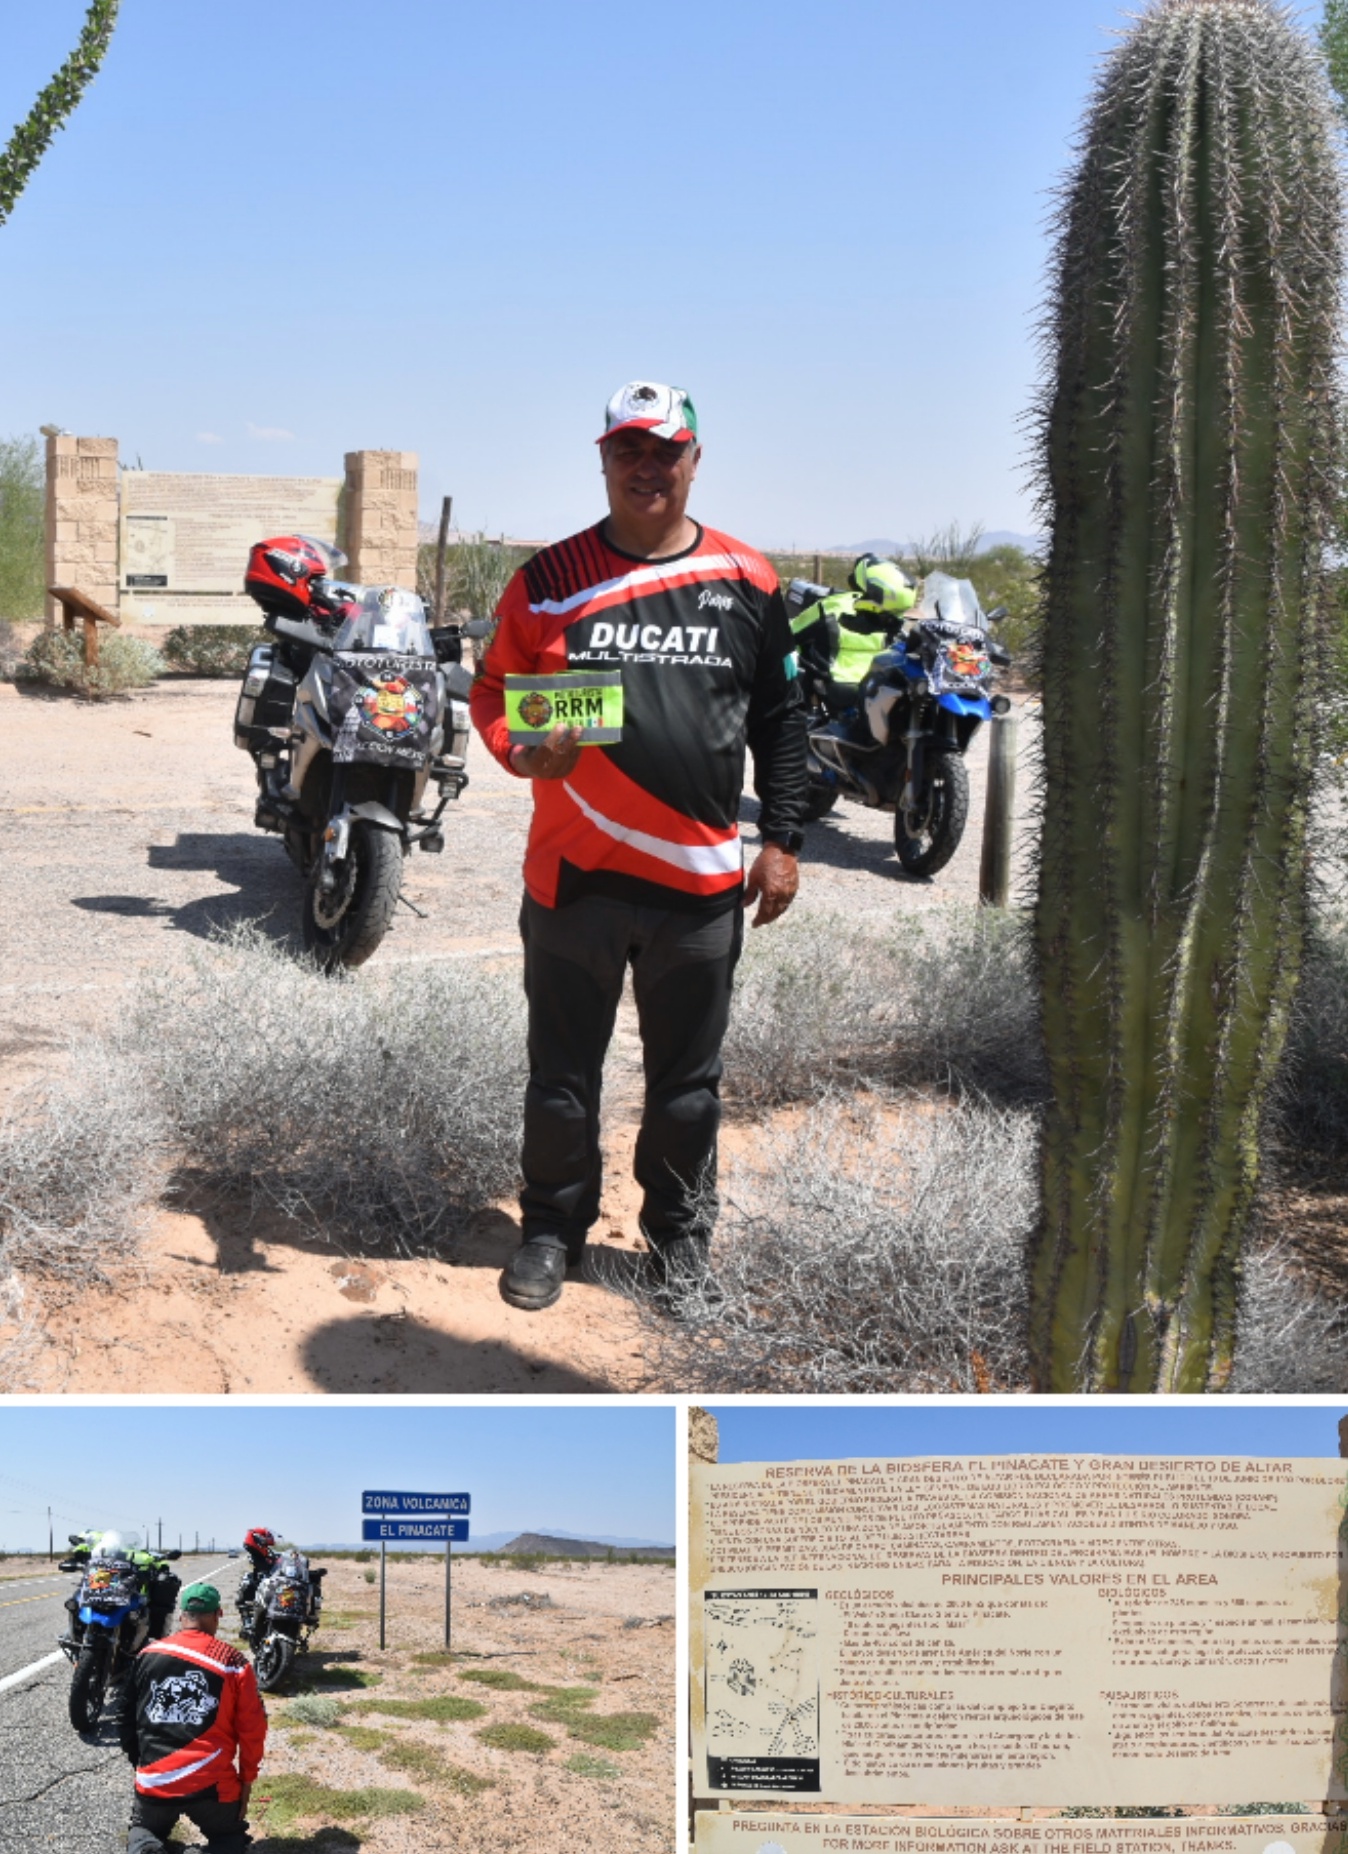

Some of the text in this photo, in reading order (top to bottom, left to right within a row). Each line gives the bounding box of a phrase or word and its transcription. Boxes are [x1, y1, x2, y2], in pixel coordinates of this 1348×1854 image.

[589, 622, 719, 653] DUCATI
[568, 651, 732, 668] MULTISTRADA
[555, 697, 603, 718] RRM
[765, 1465, 834, 1479] RESERVA
[862, 1463, 882, 1475] LA
[886, 1460, 963, 1475] BIOSFERA
[991, 1458, 1070, 1471] PINACATE
[1074, 1458, 1086, 1471] Y
[1089, 1458, 1135, 1471] GRAN
[1139, 1460, 1216, 1472] DESIERTO
[1221, 1461, 1240, 1472] DE
[1245, 1461, 1293, 1473] ALTAR
[365, 1496, 468, 1510] ZONA VOLCANICA
[380, 1525, 455, 1536] EL PINACATE
[942, 1573, 1218, 1586] PRINCIPALES VALORES EN EL AREA
[732, 1820, 801, 1833] PREGUNTA
[804, 1821, 820, 1834] EN
[825, 1823, 841, 1835] LA
[846, 1822, 910, 1837] ESTACIÓN
[915, 1824, 989, 1838] BIOLÓGICA
[993, 1826, 1041, 1839] SOBRE
[1045, 1827, 1093, 1839] OTROS
[1096, 1826, 1182, 1839] MATERIALES
[823, 1838, 1237, 1854] FOR MORE INFORMATION ASK AT THE FIELD STATION, THANKS.
